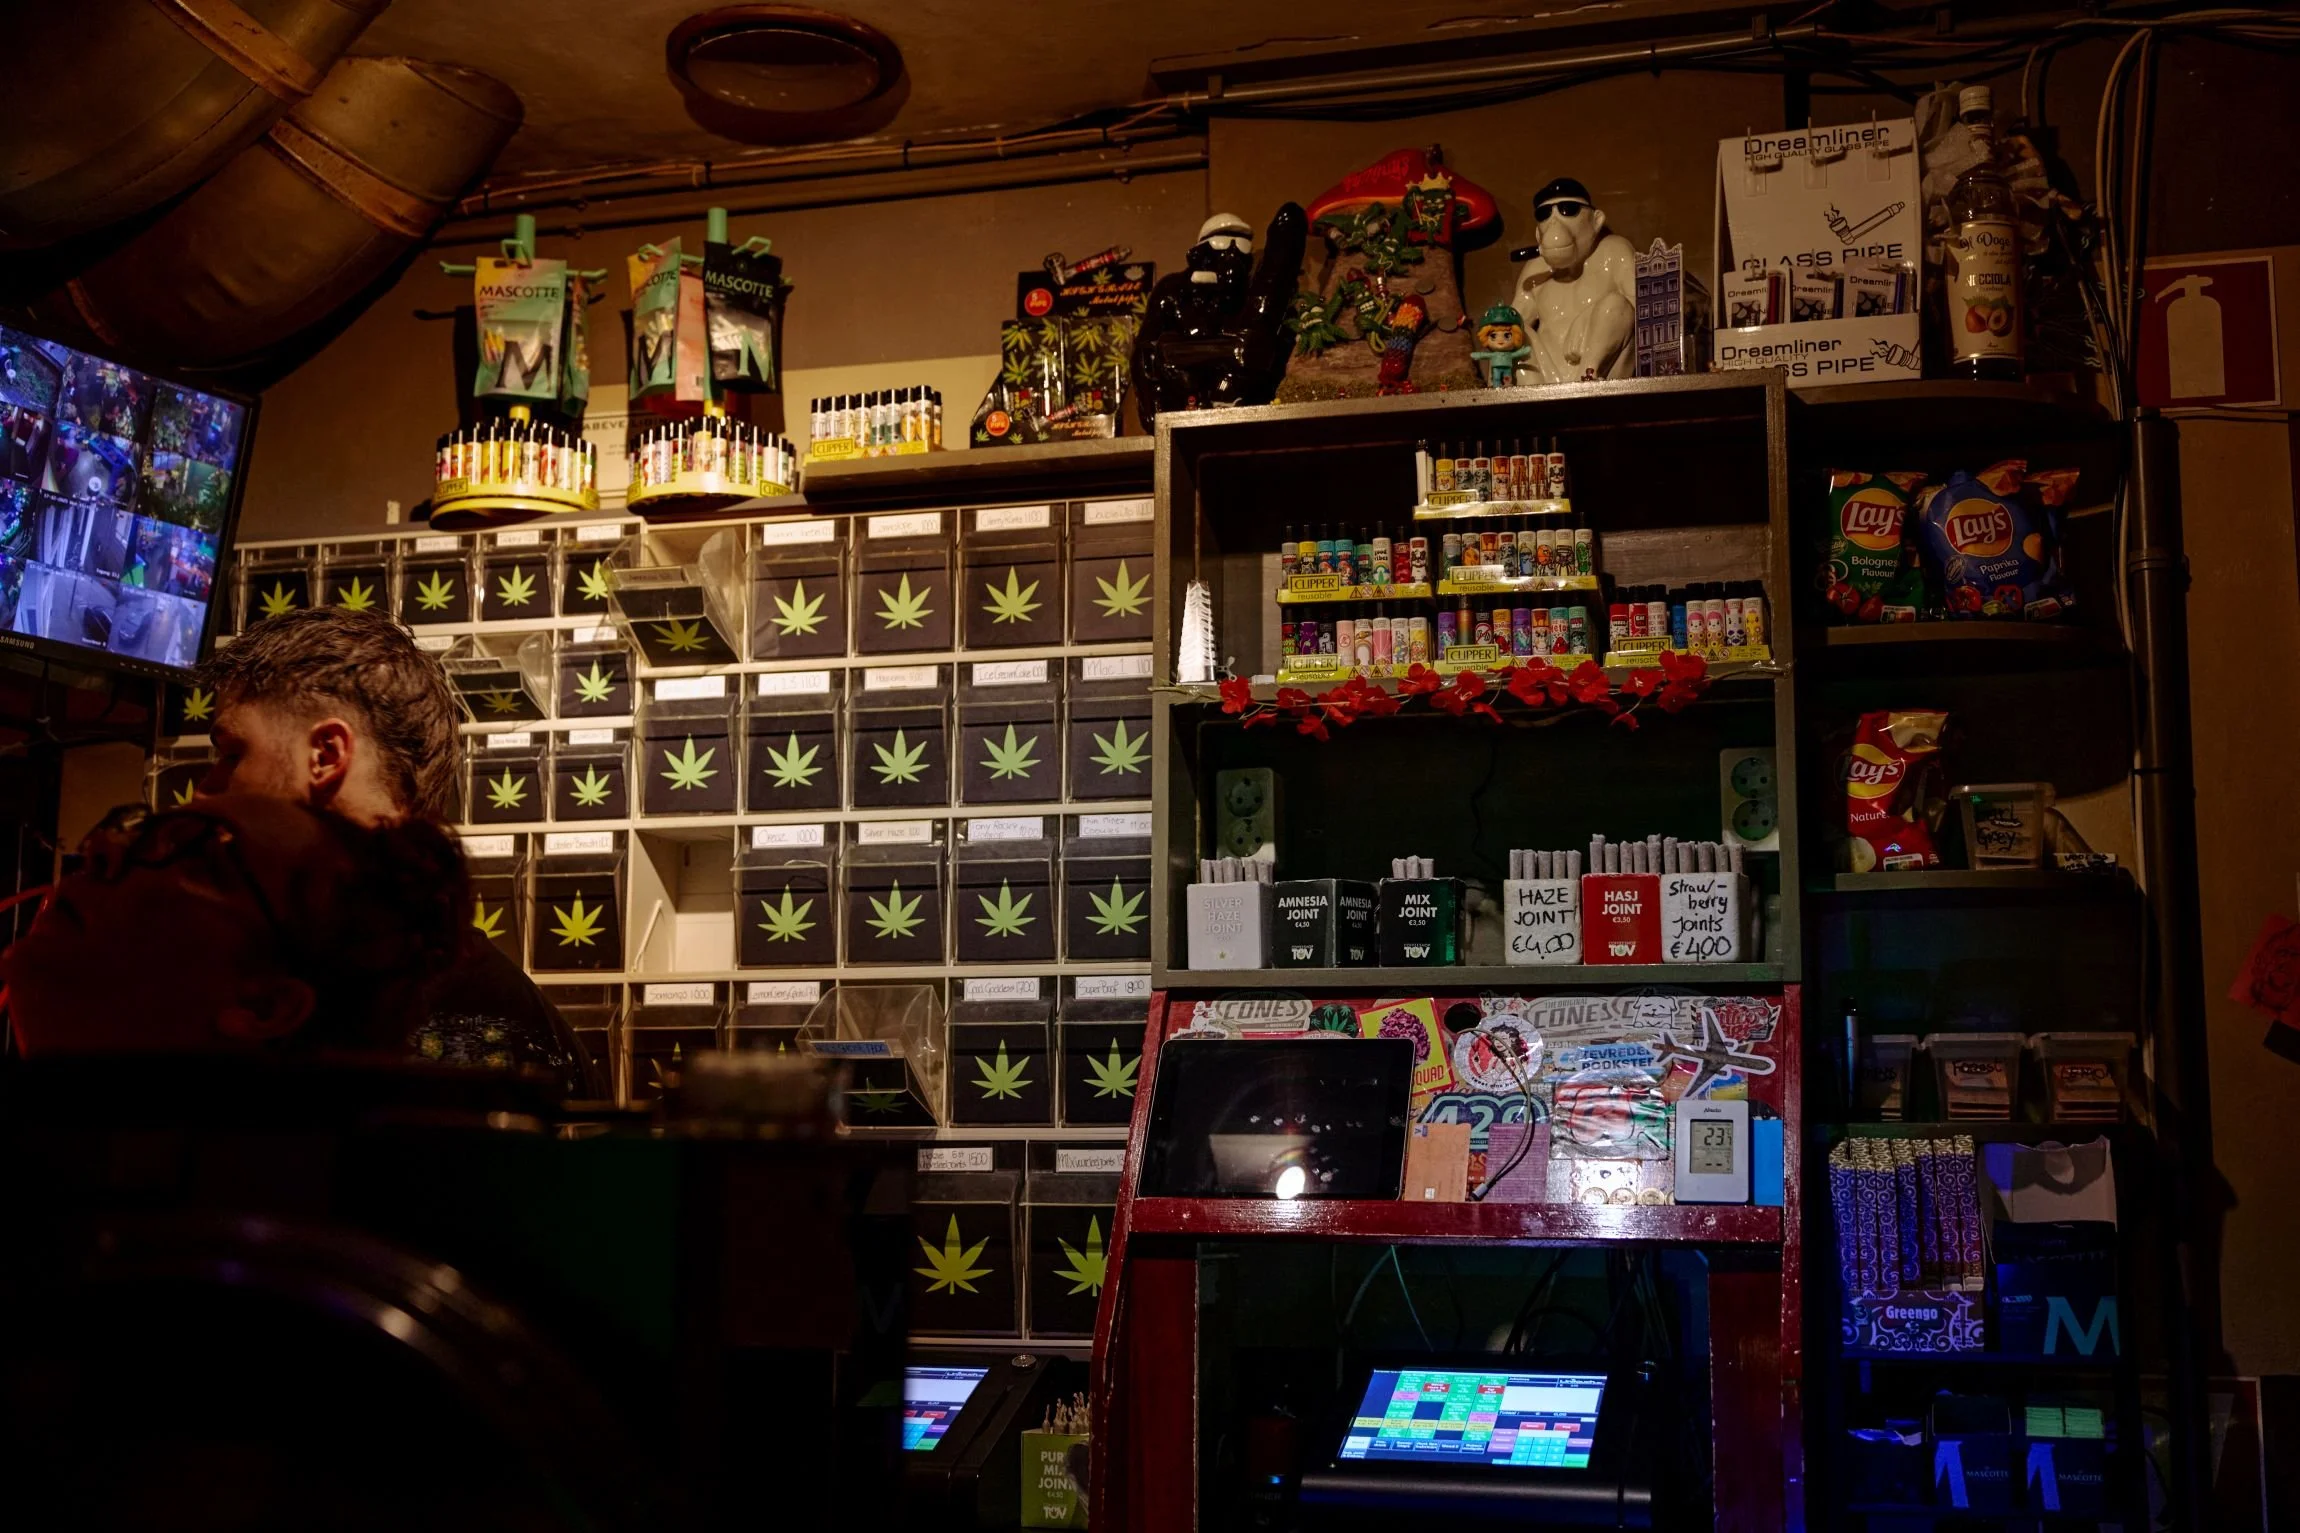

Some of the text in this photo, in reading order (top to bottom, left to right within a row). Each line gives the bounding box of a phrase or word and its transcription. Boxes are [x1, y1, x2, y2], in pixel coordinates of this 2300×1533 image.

[1744, 126, 1890, 155] Dreamliner
[704, 269, 775, 299] MASCOTTE
[479, 285, 560, 299] MASCOTTE
[1728, 287, 1768, 298] Dreamli
[1721, 339, 1842, 361] Dreamliner
[1755, 353, 1809, 365] QUALITY
[1816, 356, 1875, 376] PIPE
[582, 420, 626, 431] ABEVE
[1845, 502, 1905, 540] Lay's
[1951, 509, 2007, 548] Lay's
[1979, 559, 2020, 576] Paprika
[1989, 568, 2020, 584] Flavour
[1294, 578, 1335, 590] CLIPPER
[1459, 584, 1495, 592] reusable
[1298, 591, 1332, 601] reusable
[0, 635, 36, 650] SAMSUNG
[1623, 641, 1665, 653] CLIPPER
[1449, 650, 1495, 661] CLIPPER
[1626, 656, 1660, 665] reusabl
[1848, 758, 1900, 785] ay's
[1277, 896, 1328, 909] AMNESIA
[1339, 896, 1372, 910] AMNESIA
[1404, 893, 1431, 906] MIX
[1519, 887, 1569, 905] HAZE
[1604, 890, 1640, 903] HASJ
[1203, 898, 1243, 911] SILVER
[1601, 903, 1643, 916] JOINT
[1687, 894, 1728, 915] berry
[1208, 911, 1242, 922] HAZE
[1285, 908, 1320, 921] JOINT
[1345, 909, 1369, 922] JOINT
[1397, 906, 1438, 920] JOINT
[1514, 911, 1575, 927] JOINT
[1205, 923, 1243, 935] JOINT
[1291, 947, 1314, 961] TOV
[1403, 946, 1431, 960] TOV
[1607, 944, 1636, 957] TOV
[1222, 1000, 1299, 1020] CONES
[1534, 1002, 1613, 1028] CONES
[1414, 1064, 1444, 1086] QUAD
[1885, 1304, 1939, 1322] Greengo
[2043, 1296, 2121, 1357] M
[1040, 1451, 1066, 1462] PUR
[1966, 1470, 2009, 1480] MASCOTTE
[2058, 1472, 2104, 1483] MASCOTTE
[1043, 1506, 1068, 1521] TOV
